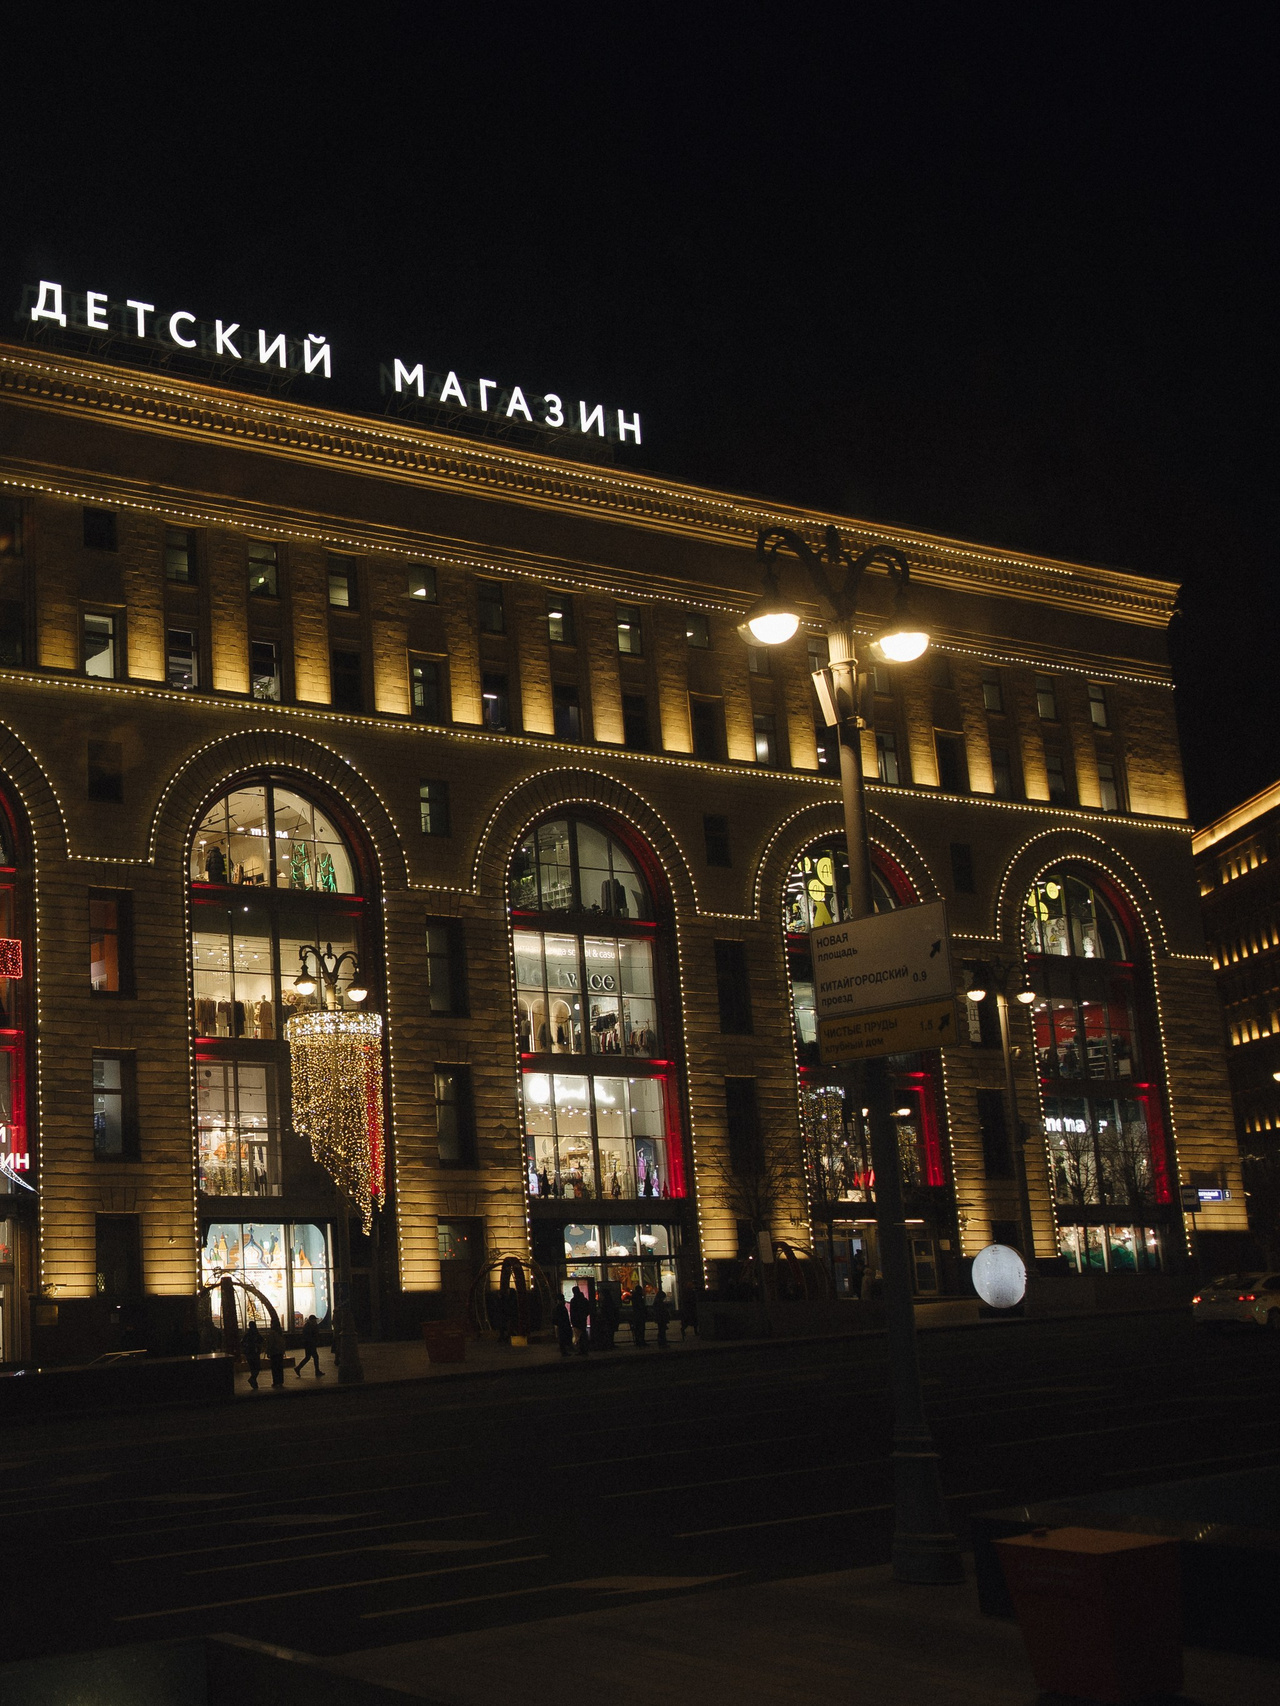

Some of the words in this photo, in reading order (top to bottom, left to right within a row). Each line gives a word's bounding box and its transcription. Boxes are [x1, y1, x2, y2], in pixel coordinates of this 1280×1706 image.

[31, 280, 332, 378] ДЕТСКИЙ
[393, 358, 642, 445] МАГАЗИН
[816, 932, 849, 949] НОВАЯ
[818, 947, 858, 962] площадь
[820, 965, 909, 993] КИТАЙГОРОДСКИЙ
[913, 971, 927, 983] 0.9
[822, 994, 854, 1008] проезд
[823, 1023, 862, 1039] ЧИСТЫЕ
[864, 1019, 898, 1033] ПРУДЫ
[920, 1020, 933, 1032] 1.5
[865, 1037, 884, 1048] дом
